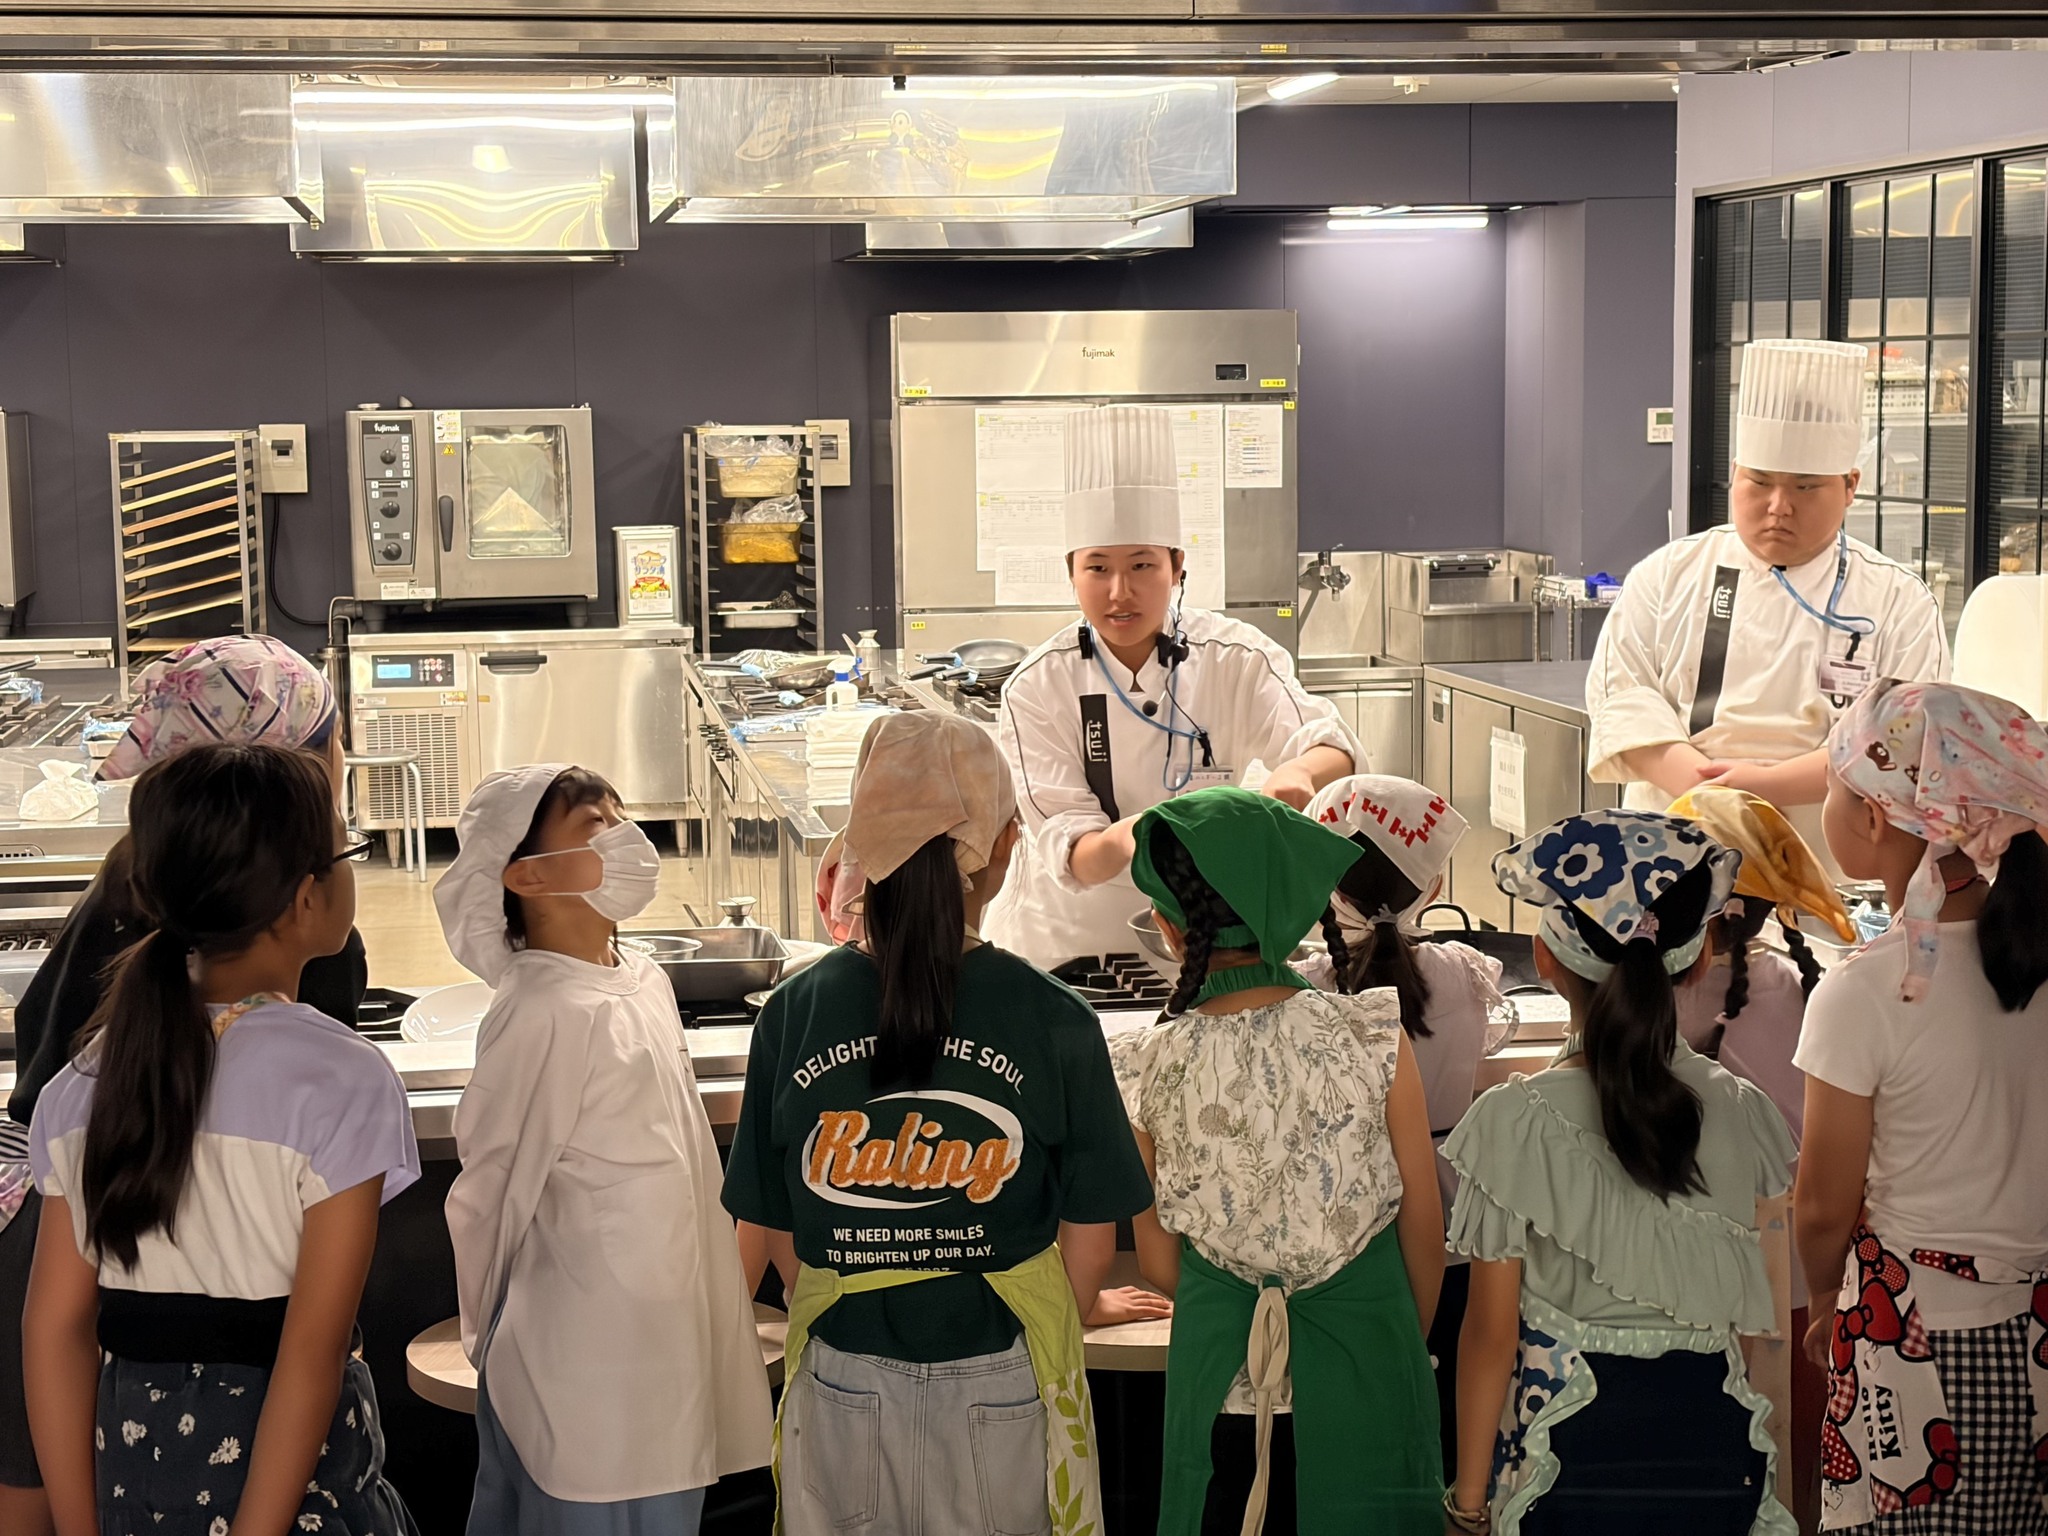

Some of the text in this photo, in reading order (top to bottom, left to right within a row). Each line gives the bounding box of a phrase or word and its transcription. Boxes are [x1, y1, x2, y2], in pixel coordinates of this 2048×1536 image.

[1082, 346, 1115, 360] fujimak
[374, 422, 400, 434] fujimak
[792, 1035, 1024, 1096] DELIGHT HE SOUL
[833, 1224, 984, 1243] WE NEED MORE SMILES
[826, 1244, 996, 1265] TO BRIGHTEN UP OUR DAY.
[1874, 1383, 1902, 1460] Kitty
